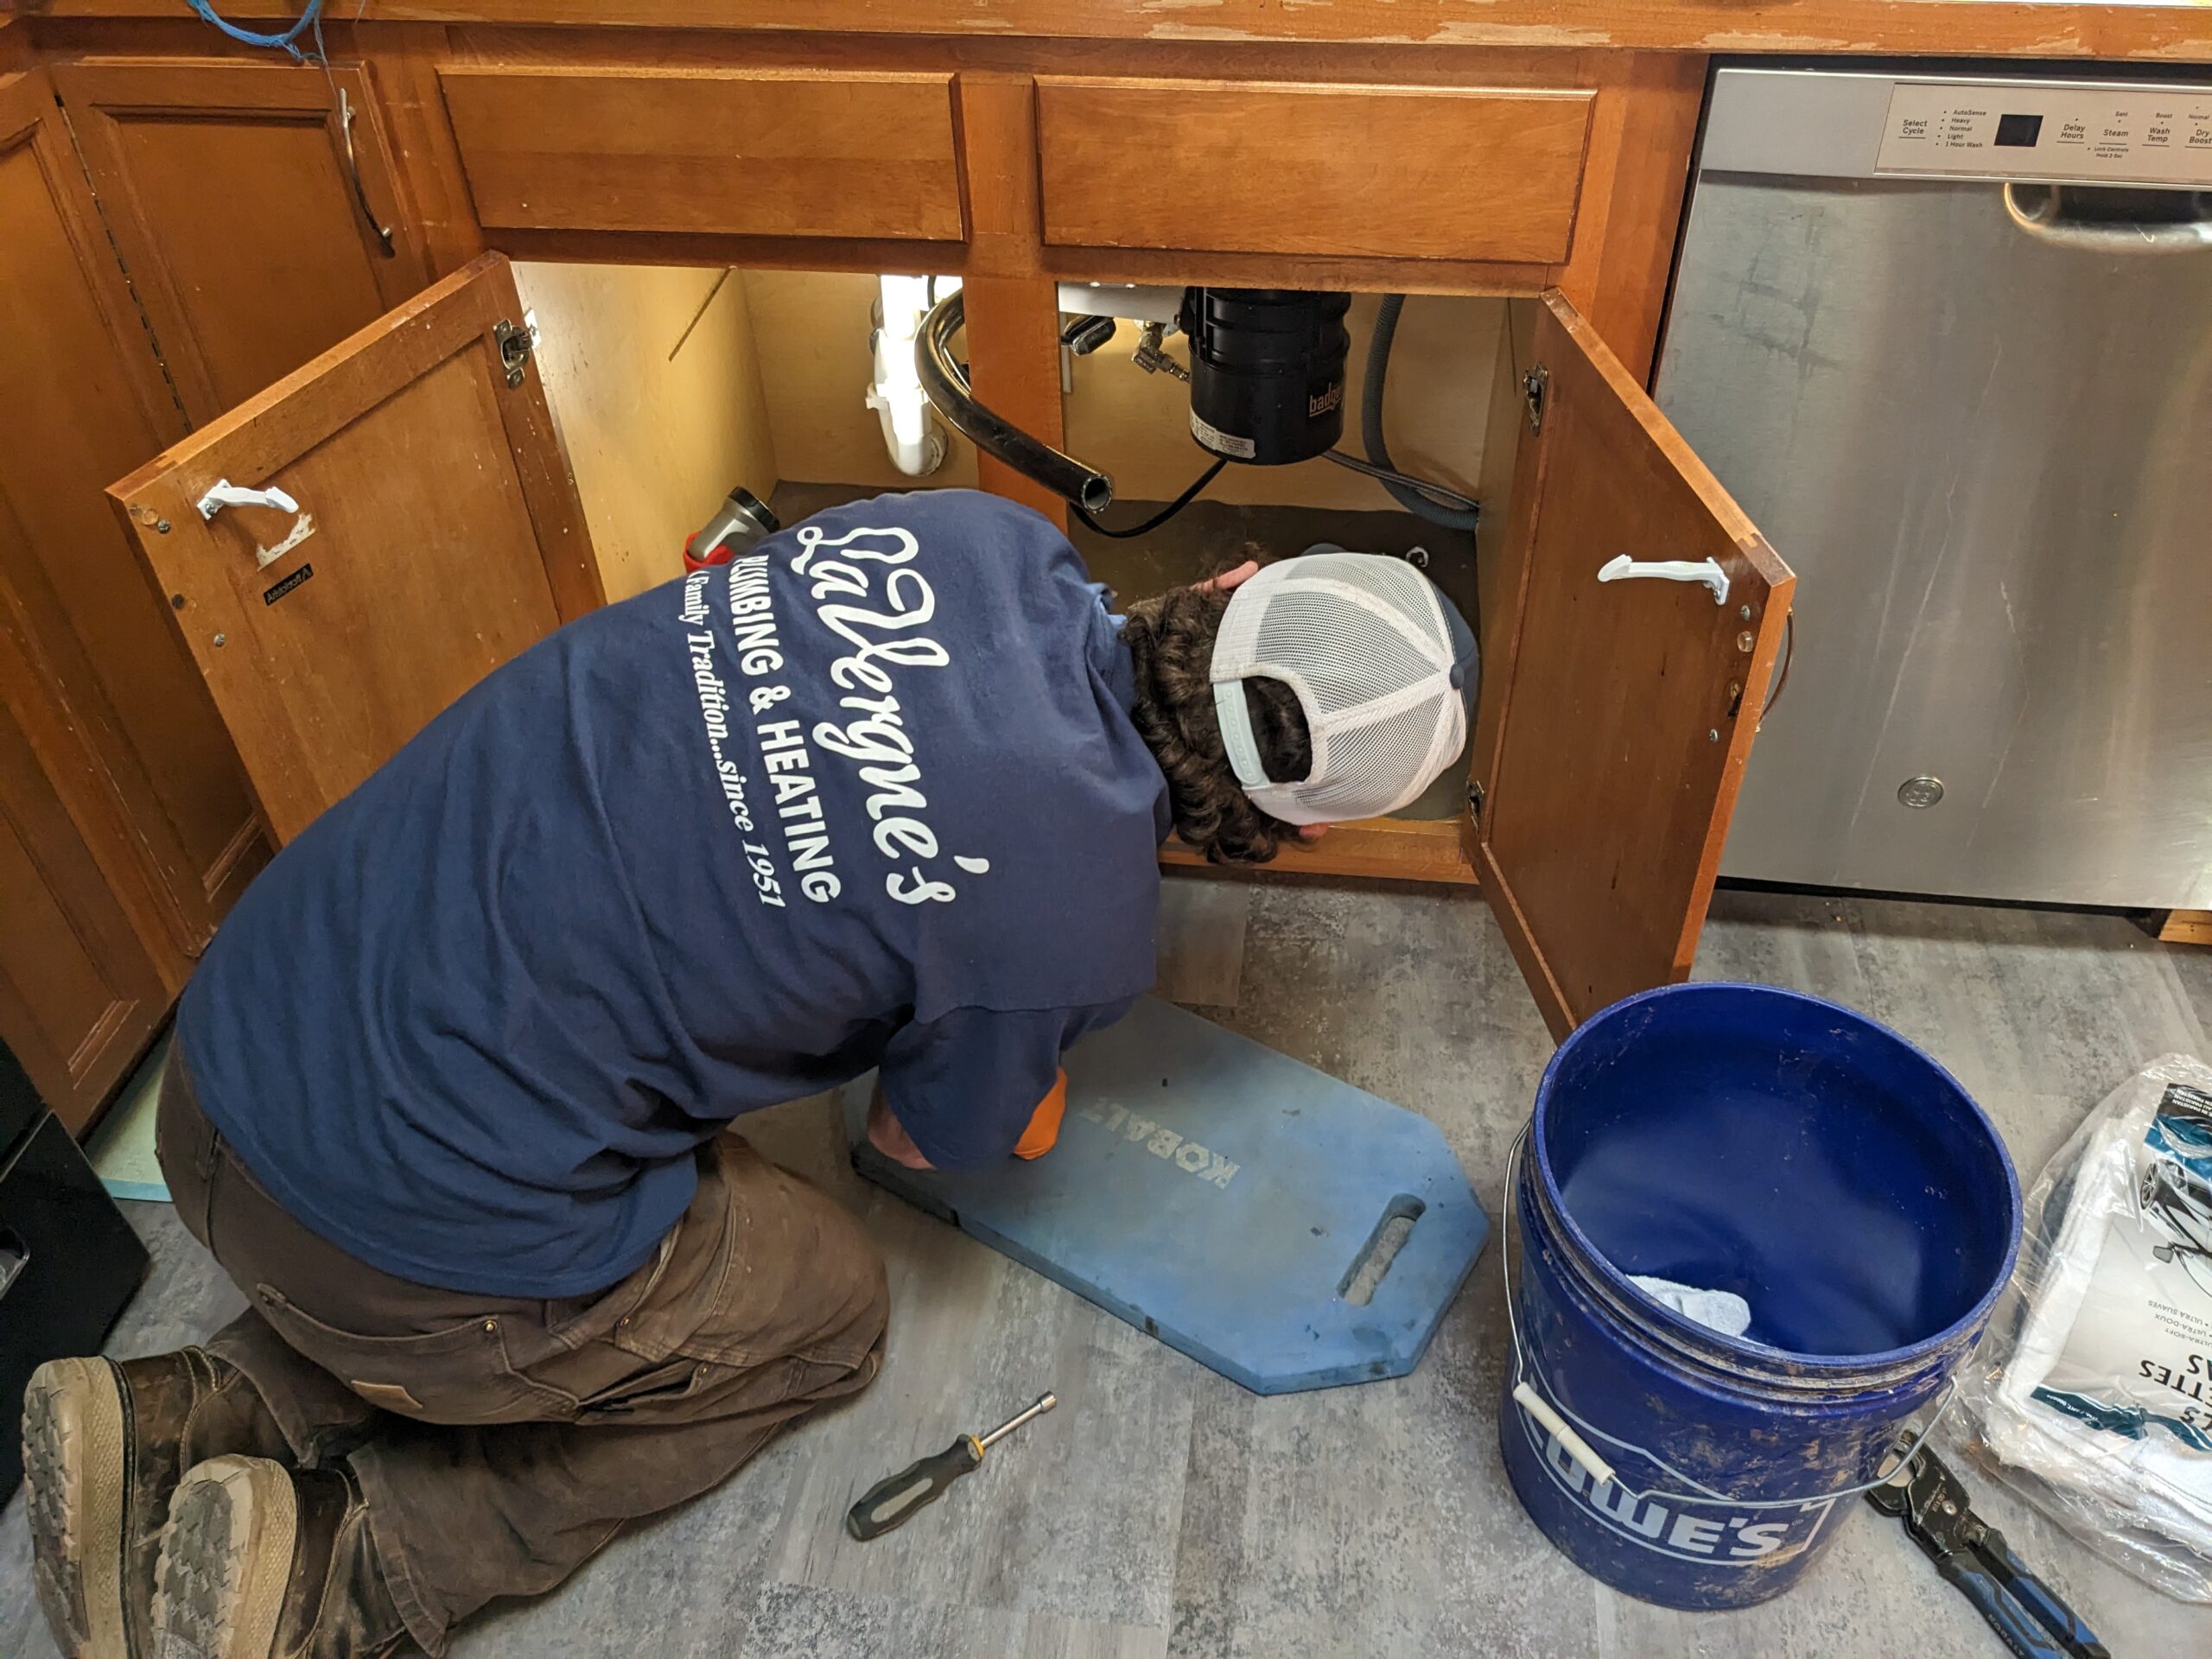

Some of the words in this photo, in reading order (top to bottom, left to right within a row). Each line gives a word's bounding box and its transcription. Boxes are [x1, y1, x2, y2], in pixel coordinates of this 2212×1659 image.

[2063, 124, 2086, 133] Delay
[2196, 129, 2209, 137] Dry
[728, 554, 784, 676] PLUMBING
[749, 685, 791, 715] &
[791, 526, 989, 905] LaVergne's
[677, 576, 710, 626] Family
[741, 839, 786, 908] 1951
[757, 720, 842, 903] HEATING
[2172, 1098, 2201, 1112] PAKISTAN
[2174, 1094, 2202, 1109] PAKISTAN
[1080, 1096, 1241, 1190] KOBALT
[2148, 1300, 2178, 1315] SUAVES
[2180, 1312, 2202, 1325] ULTRA
[2155, 1313, 2207, 1337] ULTRA-DOUX
